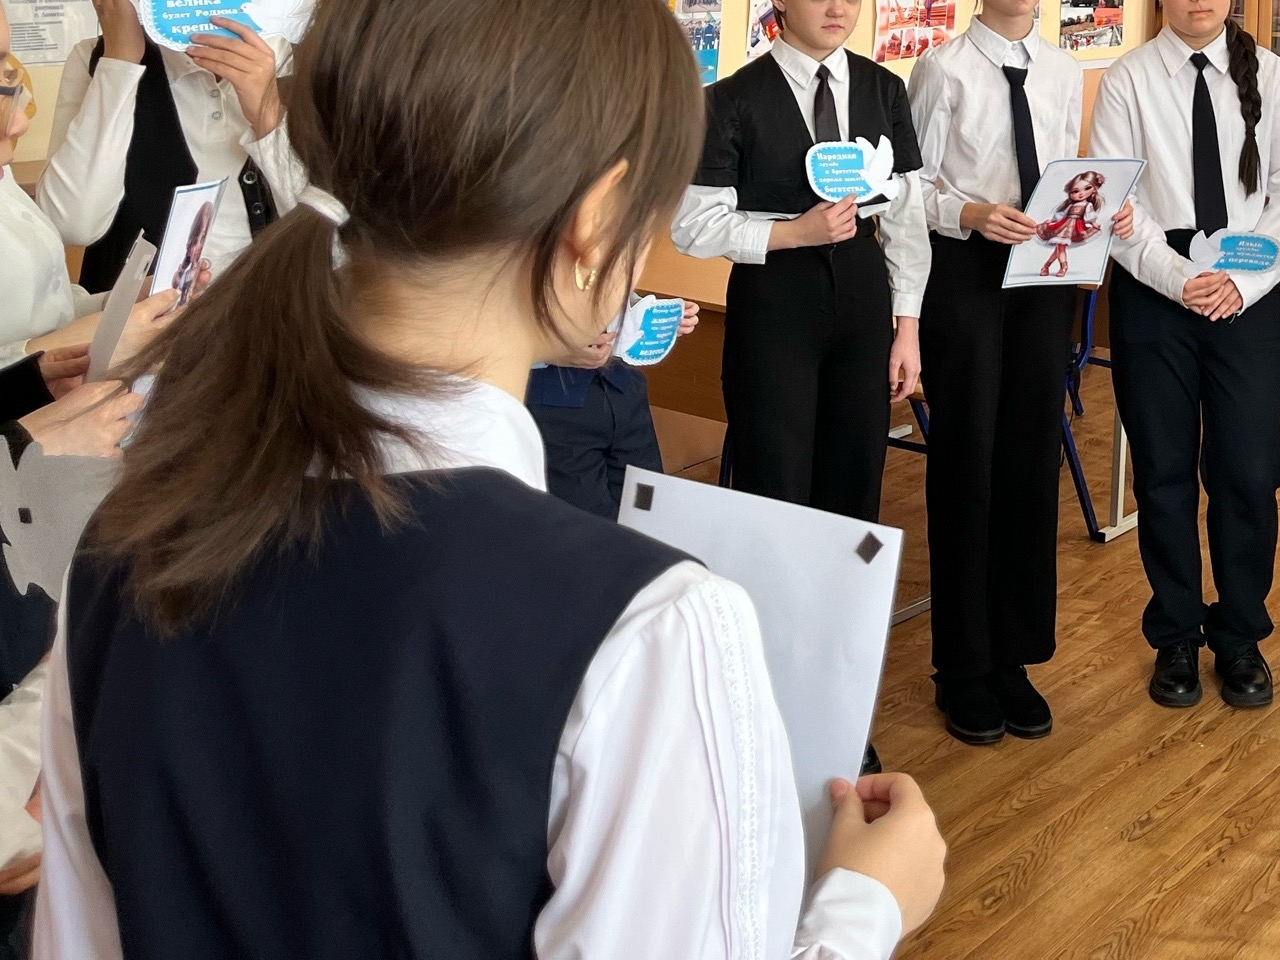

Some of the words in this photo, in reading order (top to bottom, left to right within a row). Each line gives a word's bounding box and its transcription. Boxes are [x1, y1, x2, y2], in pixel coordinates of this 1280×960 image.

[161, 11, 191, 20] будет
[194, 8, 239, 18] Родина
[171, 23, 222, 35] крепк
